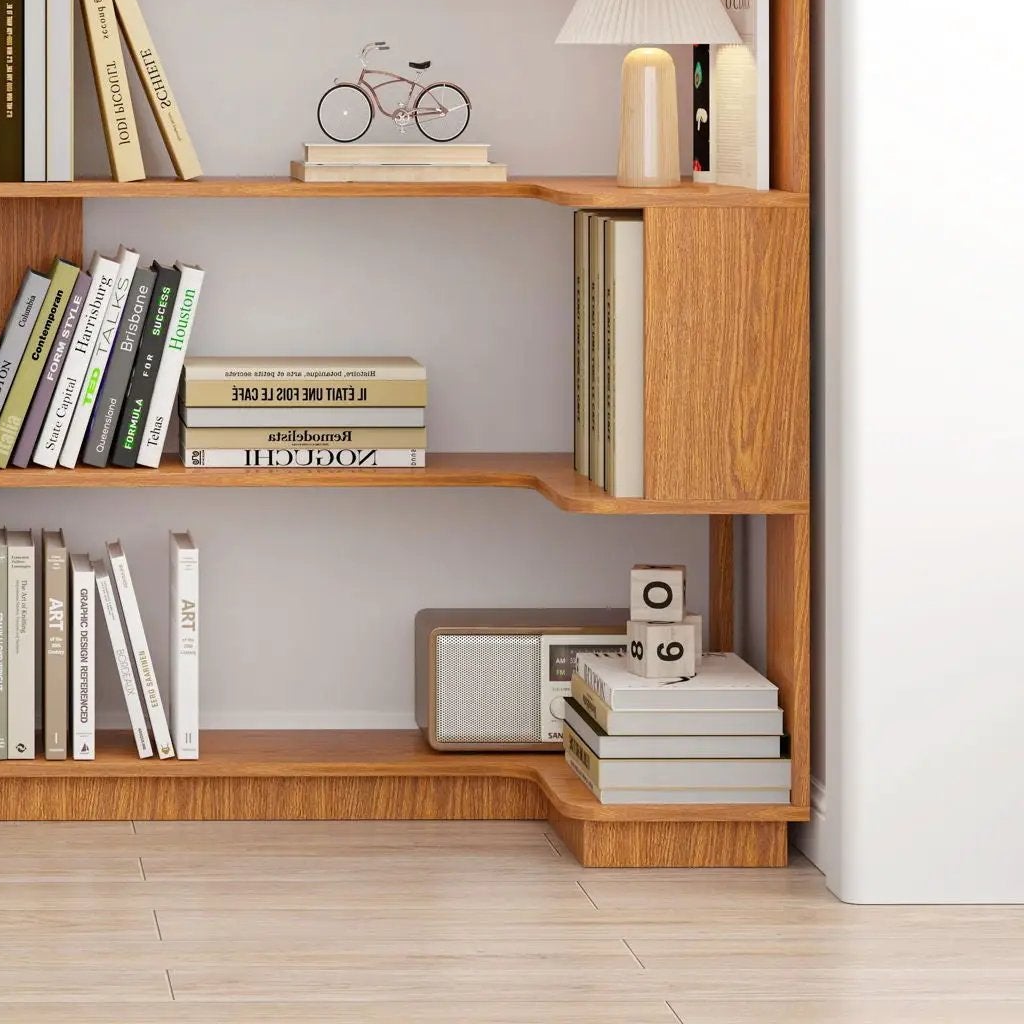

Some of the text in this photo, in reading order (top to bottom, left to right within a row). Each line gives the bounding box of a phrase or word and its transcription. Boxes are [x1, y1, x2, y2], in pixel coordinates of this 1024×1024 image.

[18, 295, 37, 328] Columbia
[31, 289, 64, 361] Contemporan
[47, 295, 83, 381] FORM STYLE
[81, 277, 130, 407] TED TALKS
[45, 275, 113, 451] State Capital Harrisburg
[95, 285, 150, 454] Queensland Brisbane
[123, 286, 171, 450] FORMULA FOR SUCCESS
[146, 287, 197, 448] Tehas Houston
[48, 598, 64, 631] ART
[80, 588, 88, 724] GRAPHIC DESIGN REFERENCED
[181, 599, 196, 632] ART
[139, 650, 159, 708] EERO SAARINEN
[555, 656, 566, 665] AM
